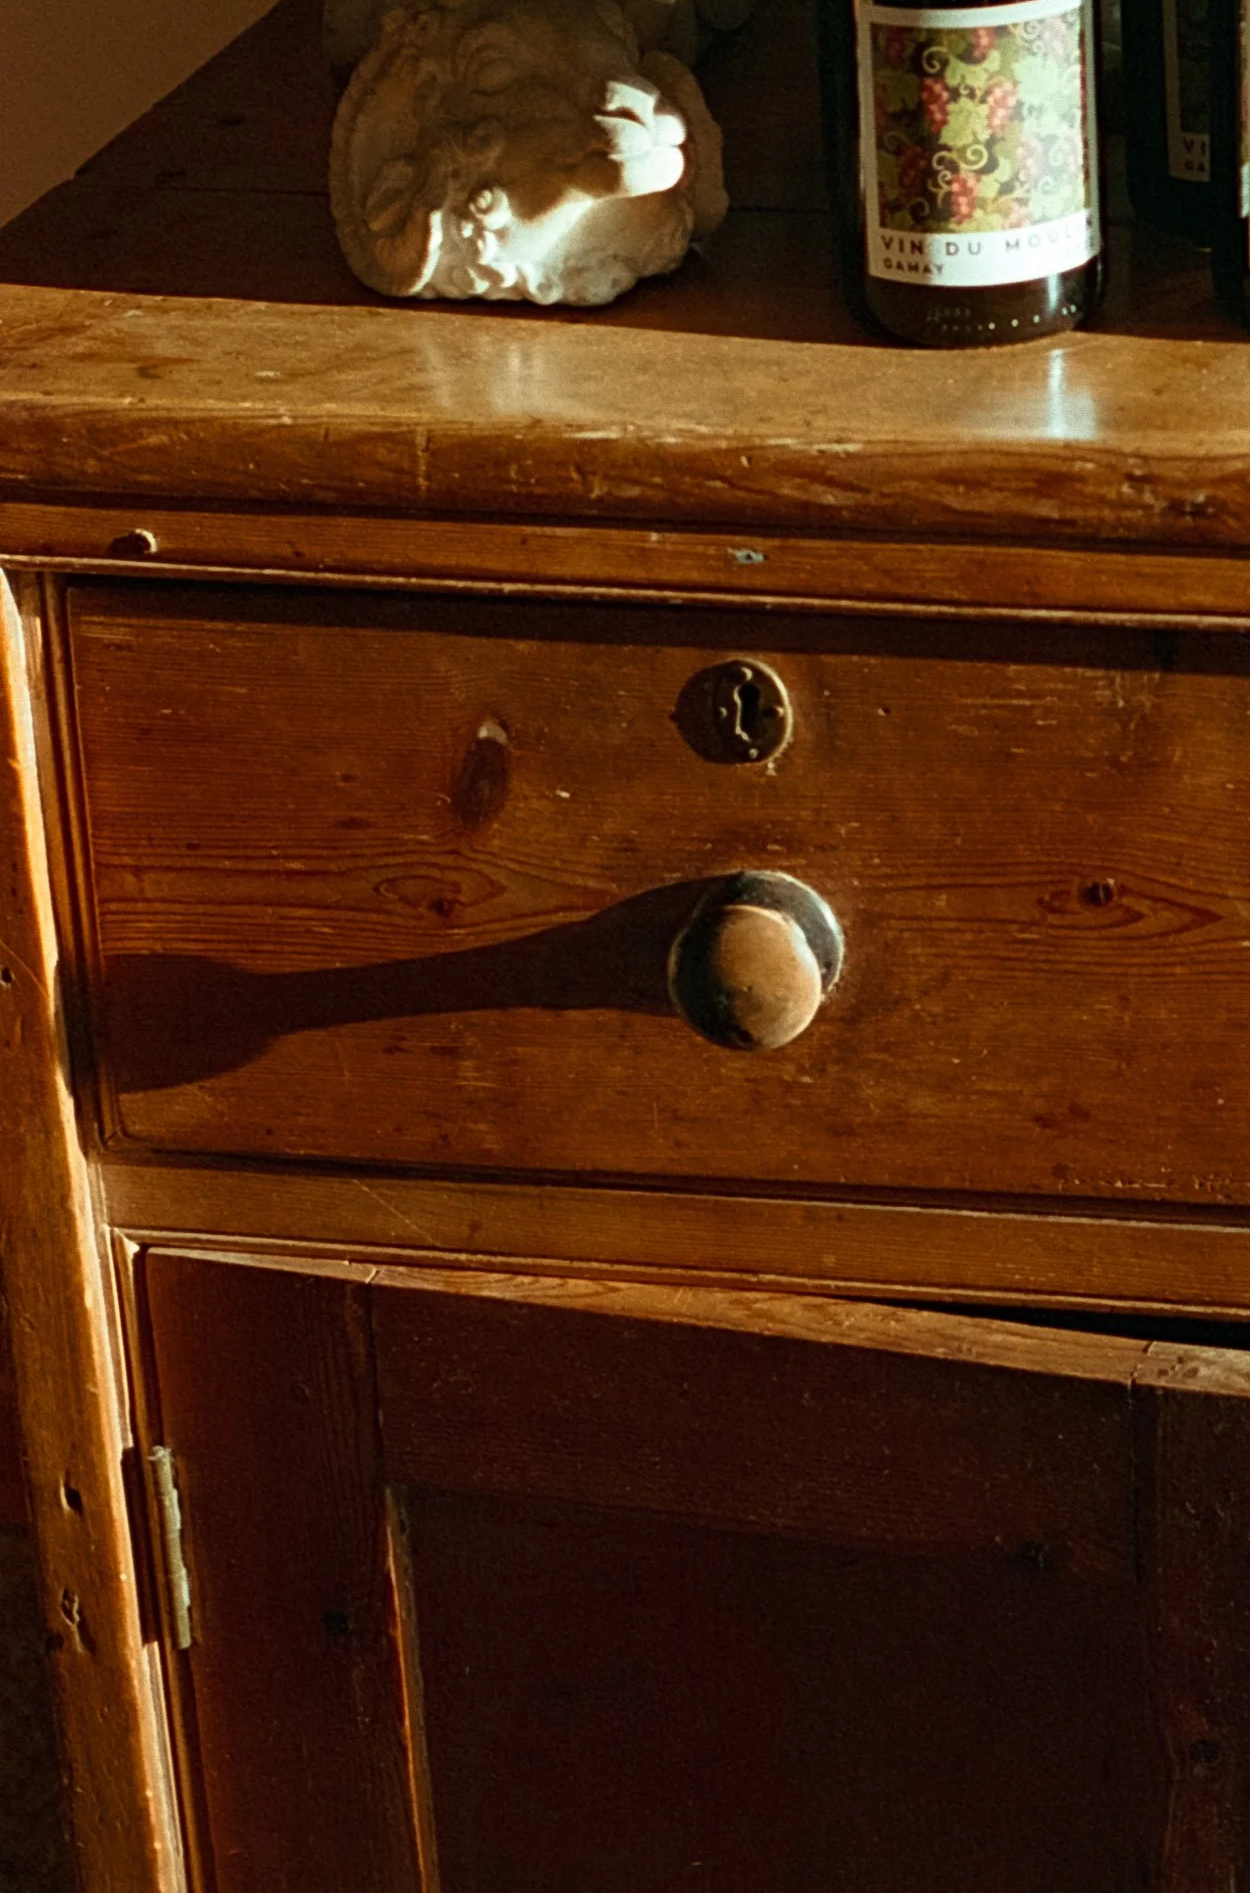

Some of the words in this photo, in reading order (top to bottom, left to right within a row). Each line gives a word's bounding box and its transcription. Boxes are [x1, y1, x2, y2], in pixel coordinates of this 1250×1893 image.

[1182, 136, 1206, 156] VI
[881, 234, 925, 256] VIN
[945, 242, 982, 257] DU
[883, 257, 944, 276] GAMAY
